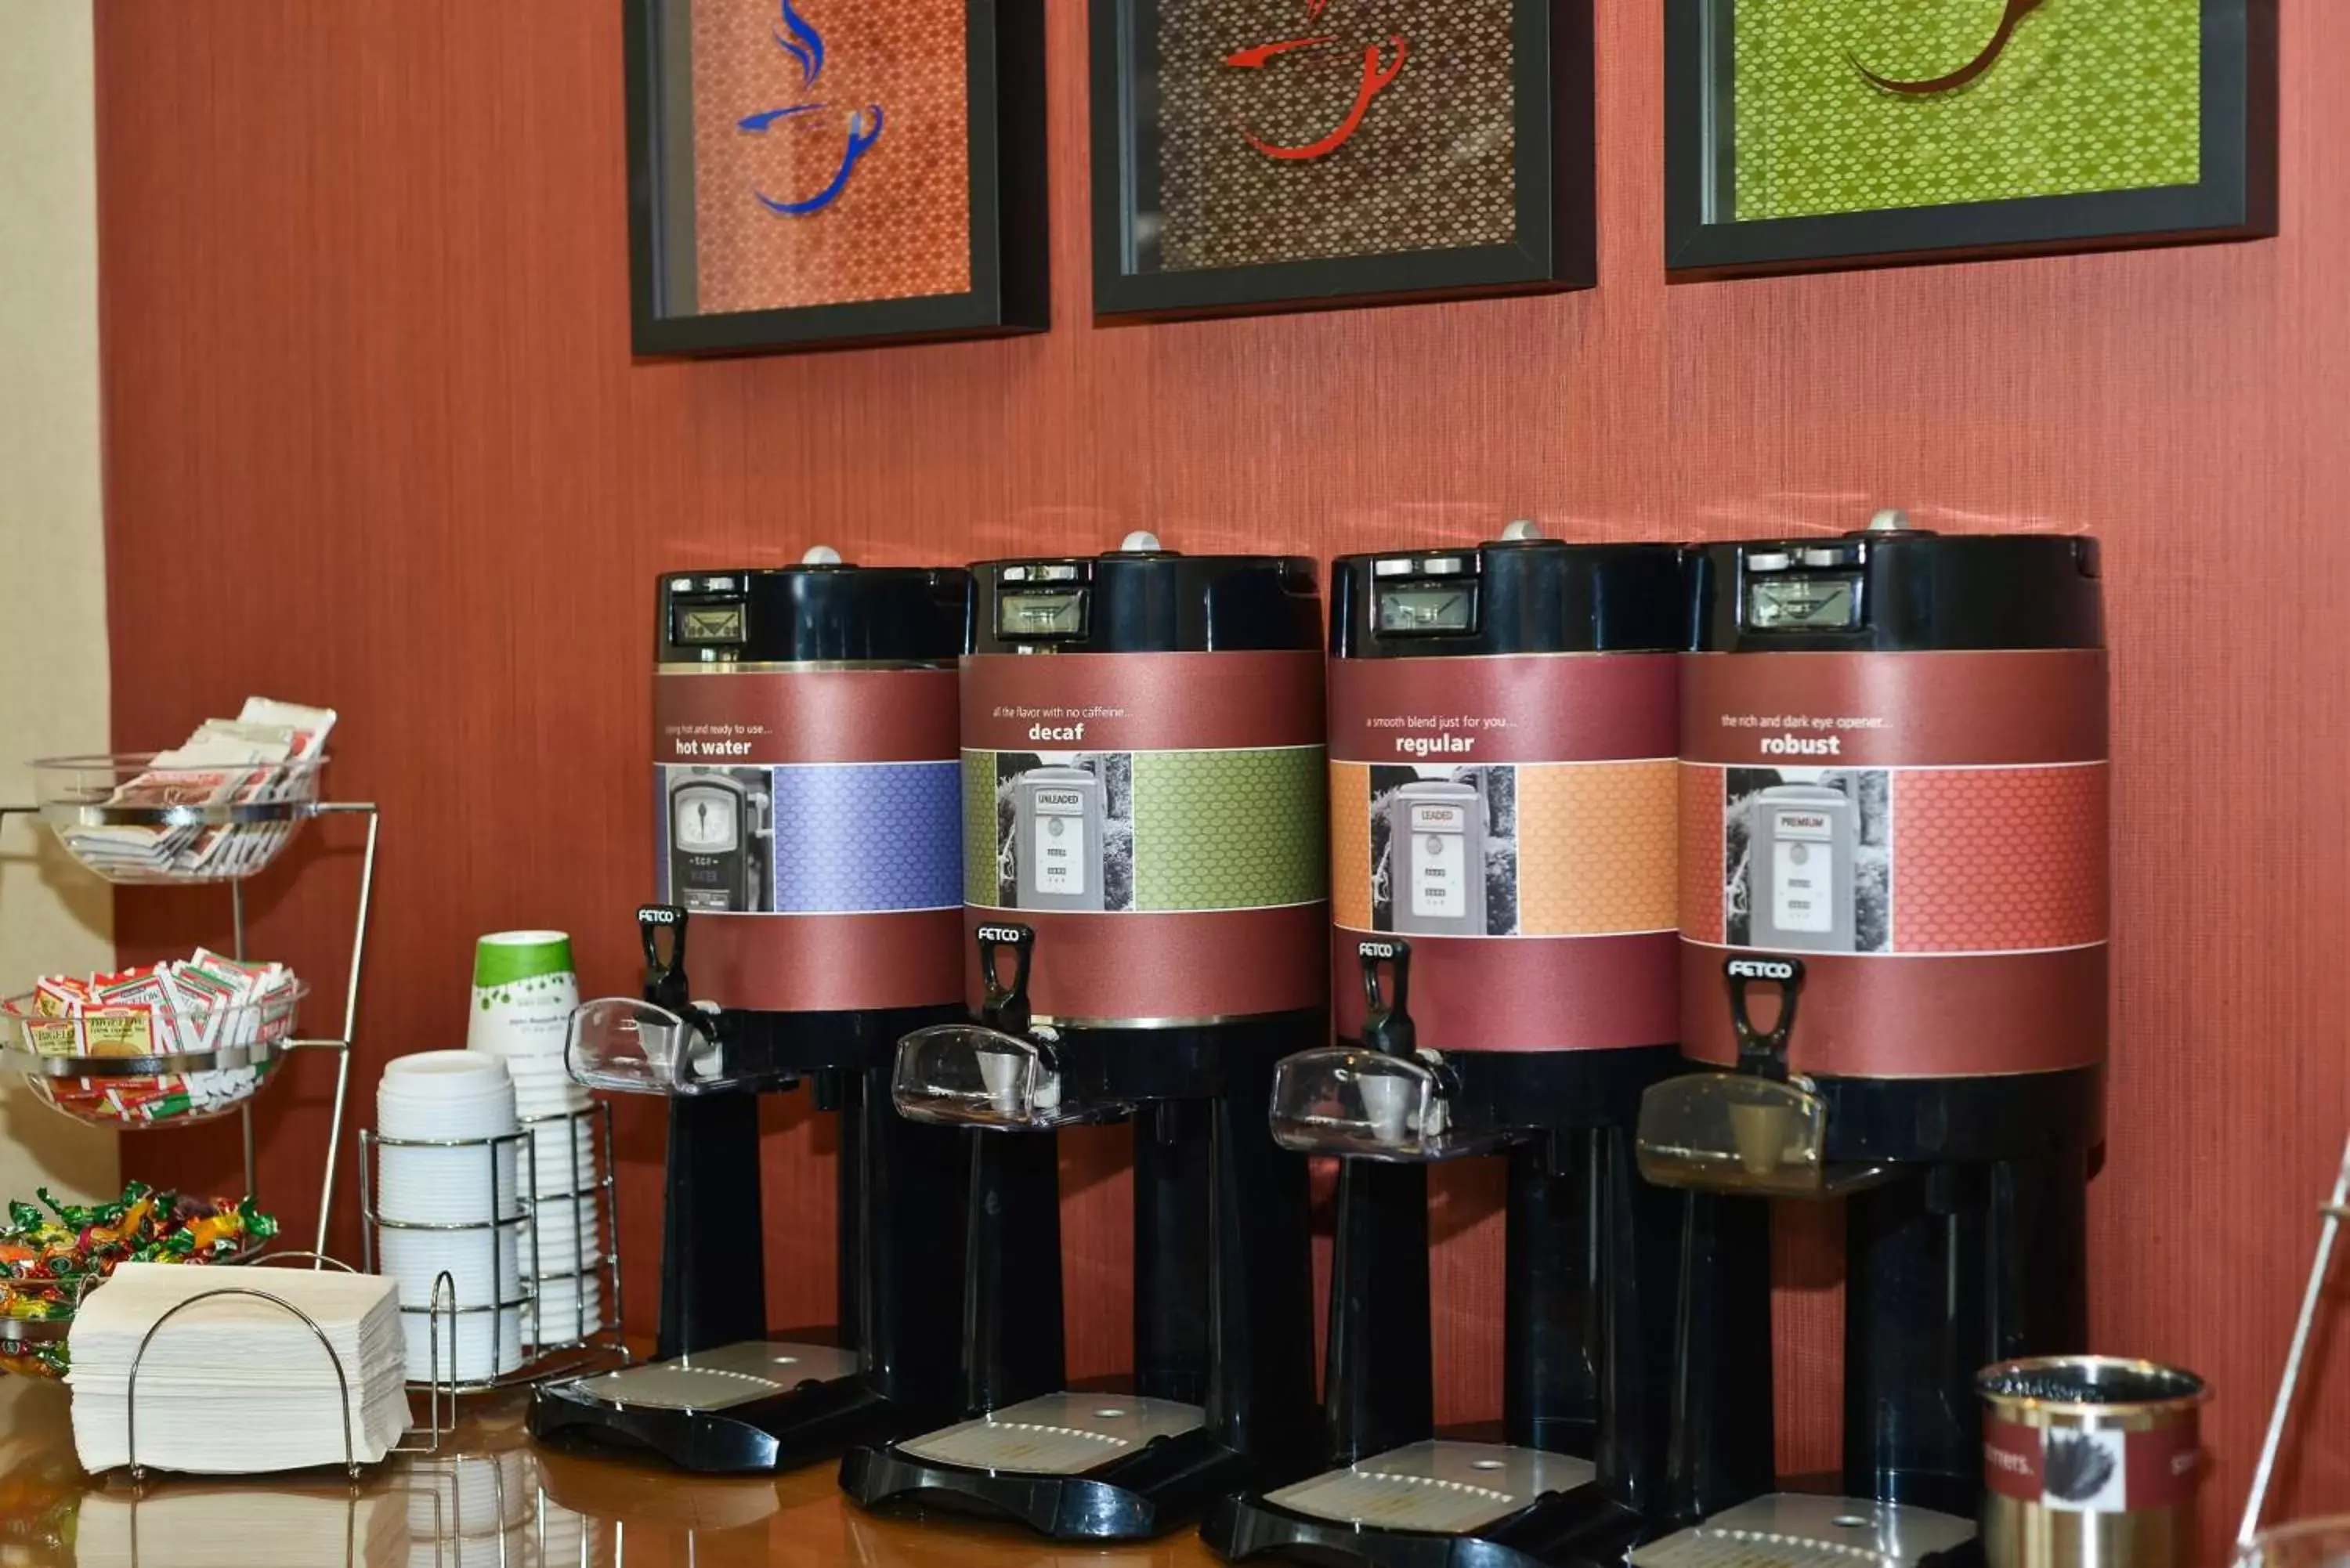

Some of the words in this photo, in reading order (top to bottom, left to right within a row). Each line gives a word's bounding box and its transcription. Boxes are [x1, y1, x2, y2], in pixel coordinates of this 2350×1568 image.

[1002, 706, 1014, 717] the
[1017, 706, 1040, 717] flavor
[1043, 706, 1064, 717] with
[1066, 709, 1079, 717] no
[710, 723, 732, 736] ready
[735, 723, 744, 734] to
[1373, 716, 1405, 728] smooth
[1408, 715, 1436, 728] blend
[1438, 716, 1459, 730] just
[1463, 715, 1479, 728] for
[1721, 714, 1736, 728] the
[1739, 714, 1757, 728] rich
[1759, 715, 1781, 728] and
[1782, 715, 1810, 728] dark
[1812, 717, 1833, 731] eye
[1029, 723, 1085, 740] decaf
[676, 737, 697, 755] hot
[701, 739, 752, 755] water
[1396, 732, 1476, 757] regular
[1761, 733, 1841, 755] robust
[1038, 794, 1079, 804] UNLEADED
[1421, 809, 1453, 820] LEADED
[1781, 817, 1824, 827] PREMIUM
[638, 909, 674, 923] FETCO
[978, 927, 1019, 942] FETCO
[1359, 942, 1393, 957] FETCO
[1728, 960, 1793, 979] FETCO
